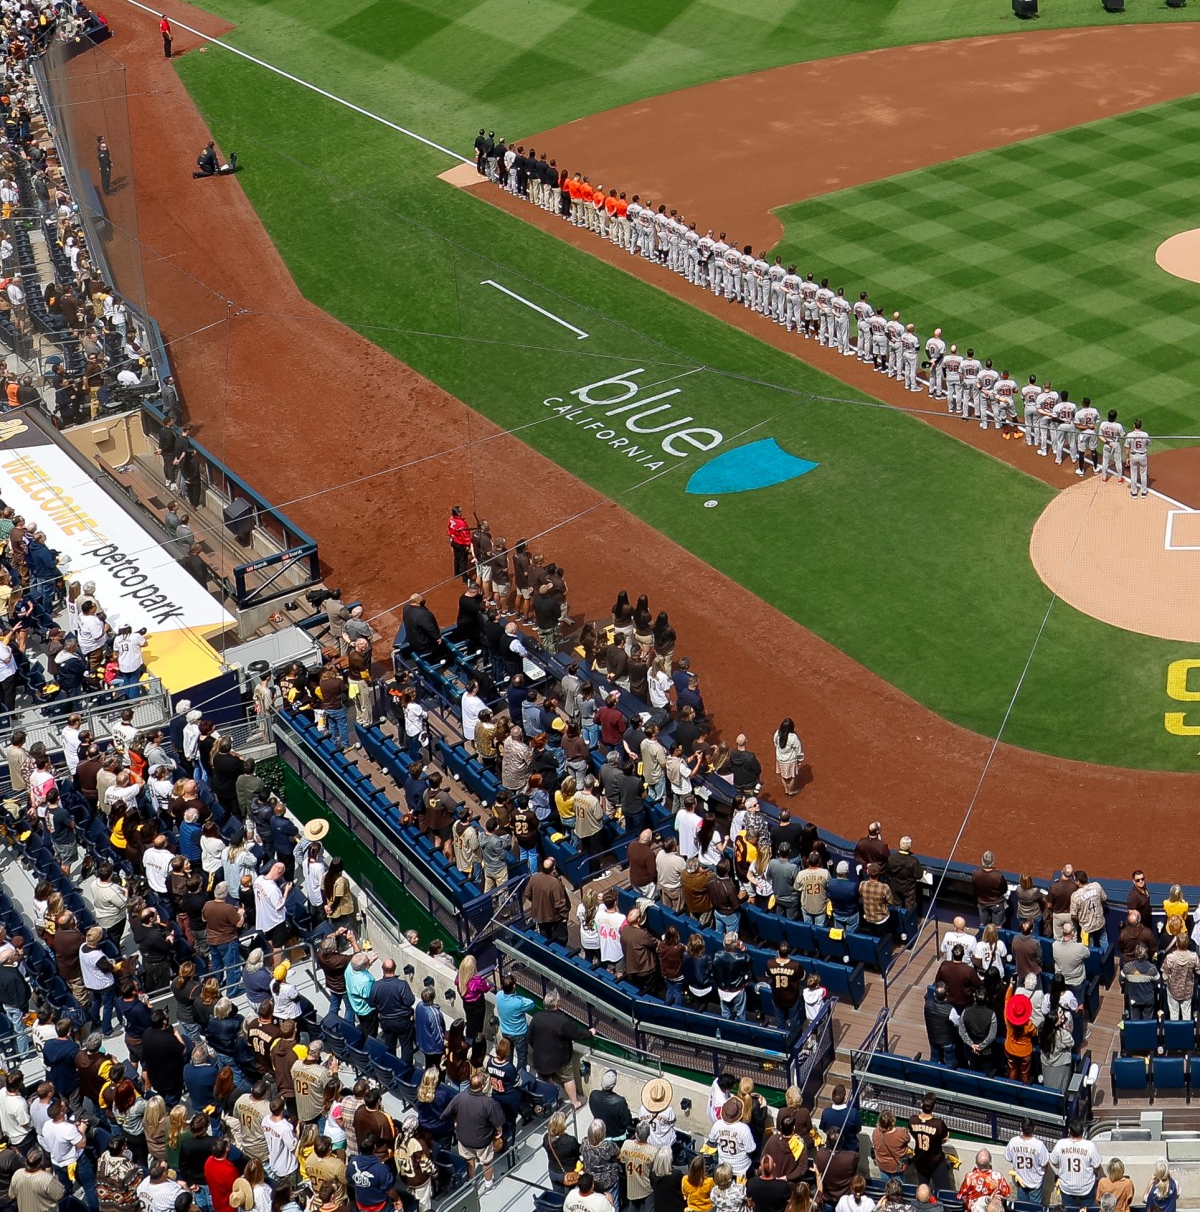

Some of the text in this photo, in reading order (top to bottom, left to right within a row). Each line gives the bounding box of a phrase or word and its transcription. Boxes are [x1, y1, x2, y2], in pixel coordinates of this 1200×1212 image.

[570, 368, 723, 458] blue
[1060, 410, 1070, 418] 31
[1085, 417, 1092, 425] 2
[543, 397, 665, 471] CALIFORNIA
[1135, 441, 1142, 449] 6
[1, 455, 185, 625] WELCOME petco park
[121, 643, 129, 652] 13
[576, 807, 585, 819] 13
[515, 822, 528, 835] 22
[806, 884, 821, 895] 23
[1087, 900, 1096, 912] 4
[600, 926, 617, 940] 44
[775, 975, 788, 988] 13
[253, 1038, 265, 1055] 44
[296, 1081, 309, 1095] 02
[720, 1139, 737, 1154] 23
[918, 1135, 930, 1151] 13
[1013, 1147, 1028, 1156] TATIS
[1061, 1147, 1088, 1156] MACHADO
[626, 1162, 643, 1176] 44
[1017, 1156, 1033, 1169] 23
[1067, 1158, 1081, 1172] 13
